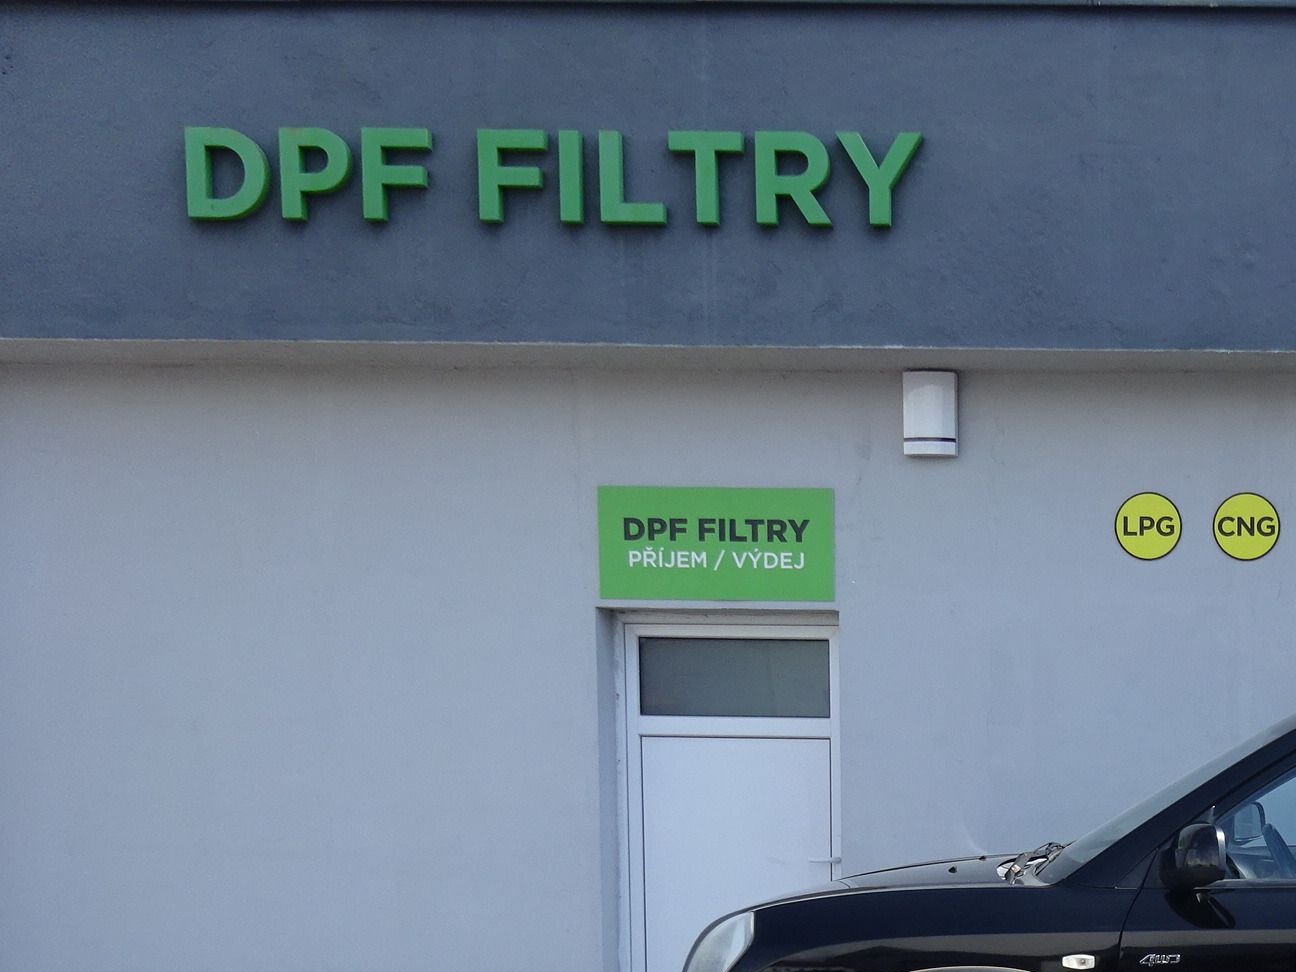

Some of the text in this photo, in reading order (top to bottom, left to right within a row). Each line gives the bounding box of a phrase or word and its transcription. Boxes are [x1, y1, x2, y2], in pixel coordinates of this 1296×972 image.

[184, 126, 924, 229] DPF FILTRY
[623, 517, 810, 543] DPF FILTRY
[1123, 516, 1175, 537] LPG
[1217, 516, 1276, 537] CNG
[628, 547, 707, 569] PŘÍJEM
[732, 548, 805, 570] VÝDEJ
